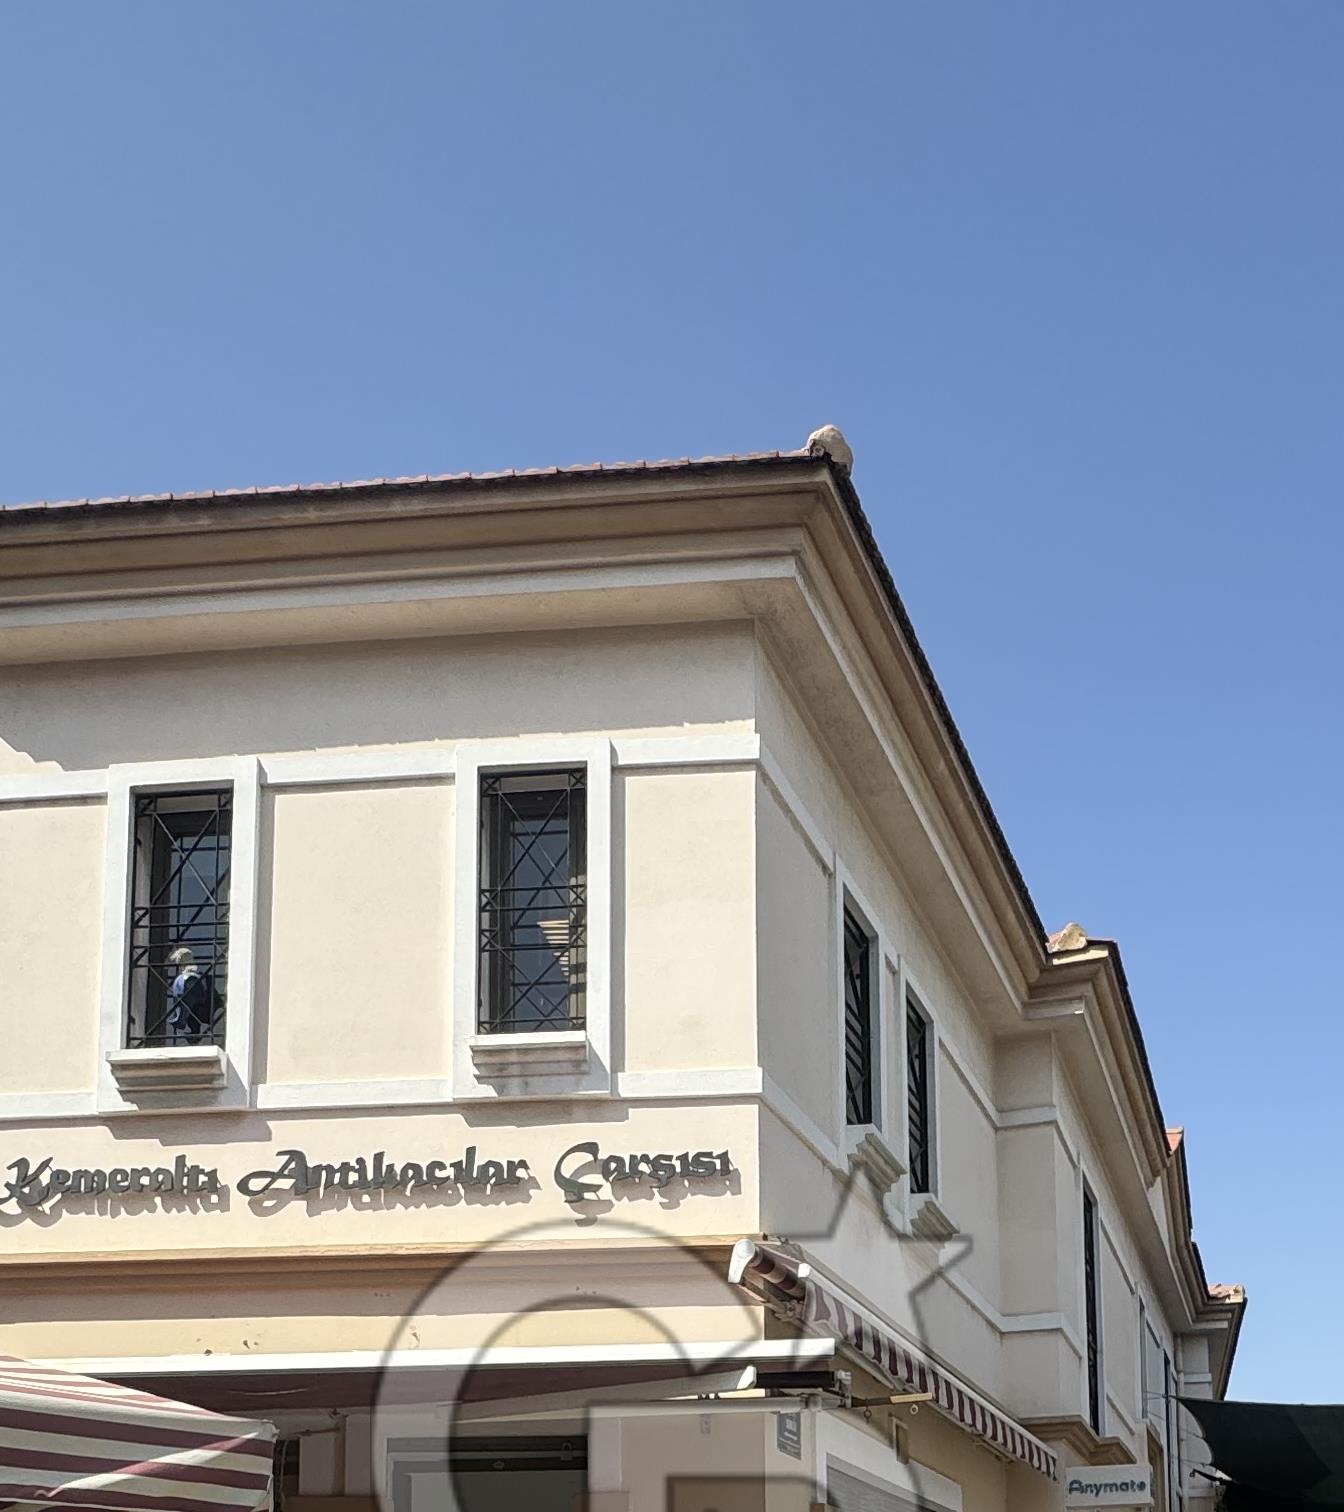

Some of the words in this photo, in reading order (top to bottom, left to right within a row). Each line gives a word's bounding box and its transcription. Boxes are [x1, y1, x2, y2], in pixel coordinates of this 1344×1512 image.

[237, 1146, 531, 1197] Antikacılar
[554, 1141, 731, 1204] Çarşısı
[1069, 1480, 1146, 1497] Anymate
